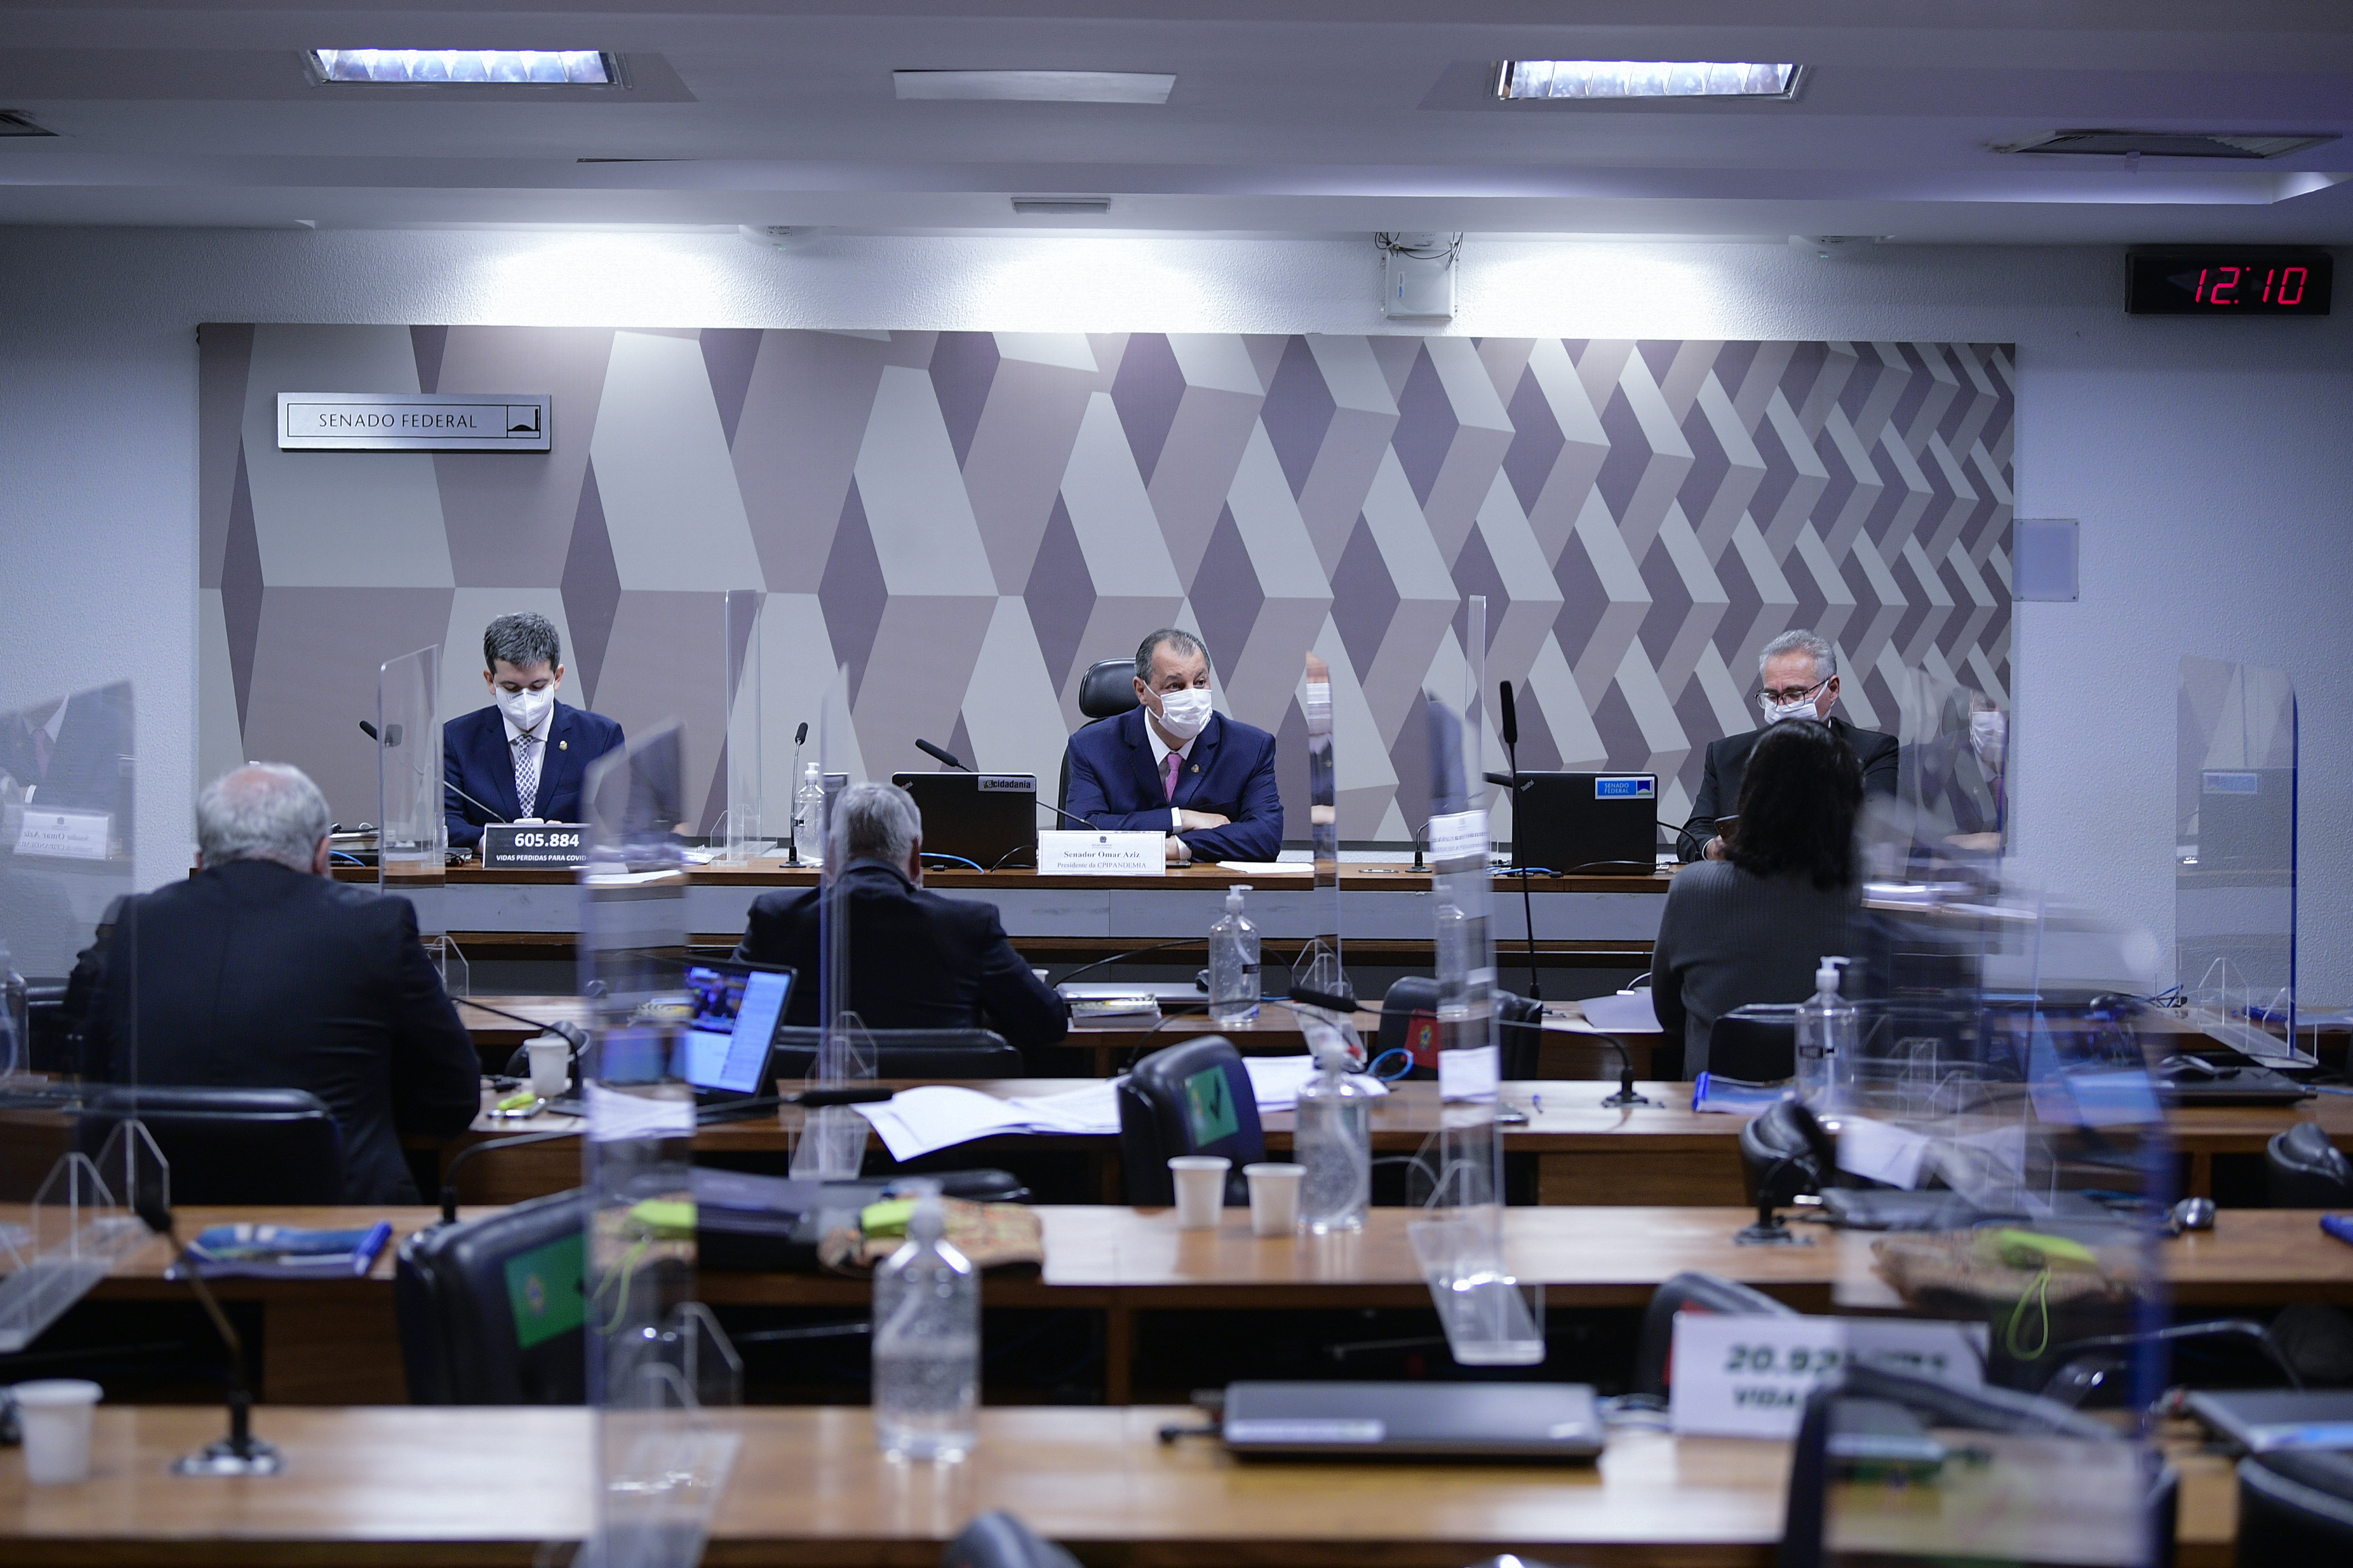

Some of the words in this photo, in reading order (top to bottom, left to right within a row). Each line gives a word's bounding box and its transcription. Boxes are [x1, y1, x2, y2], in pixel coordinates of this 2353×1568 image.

[2195, 266, 2308, 305] 12:10
[319, 413, 395, 428] SENADO
[402, 414, 478, 428] FEDERAL
[515, 833, 580, 848] 605.884
